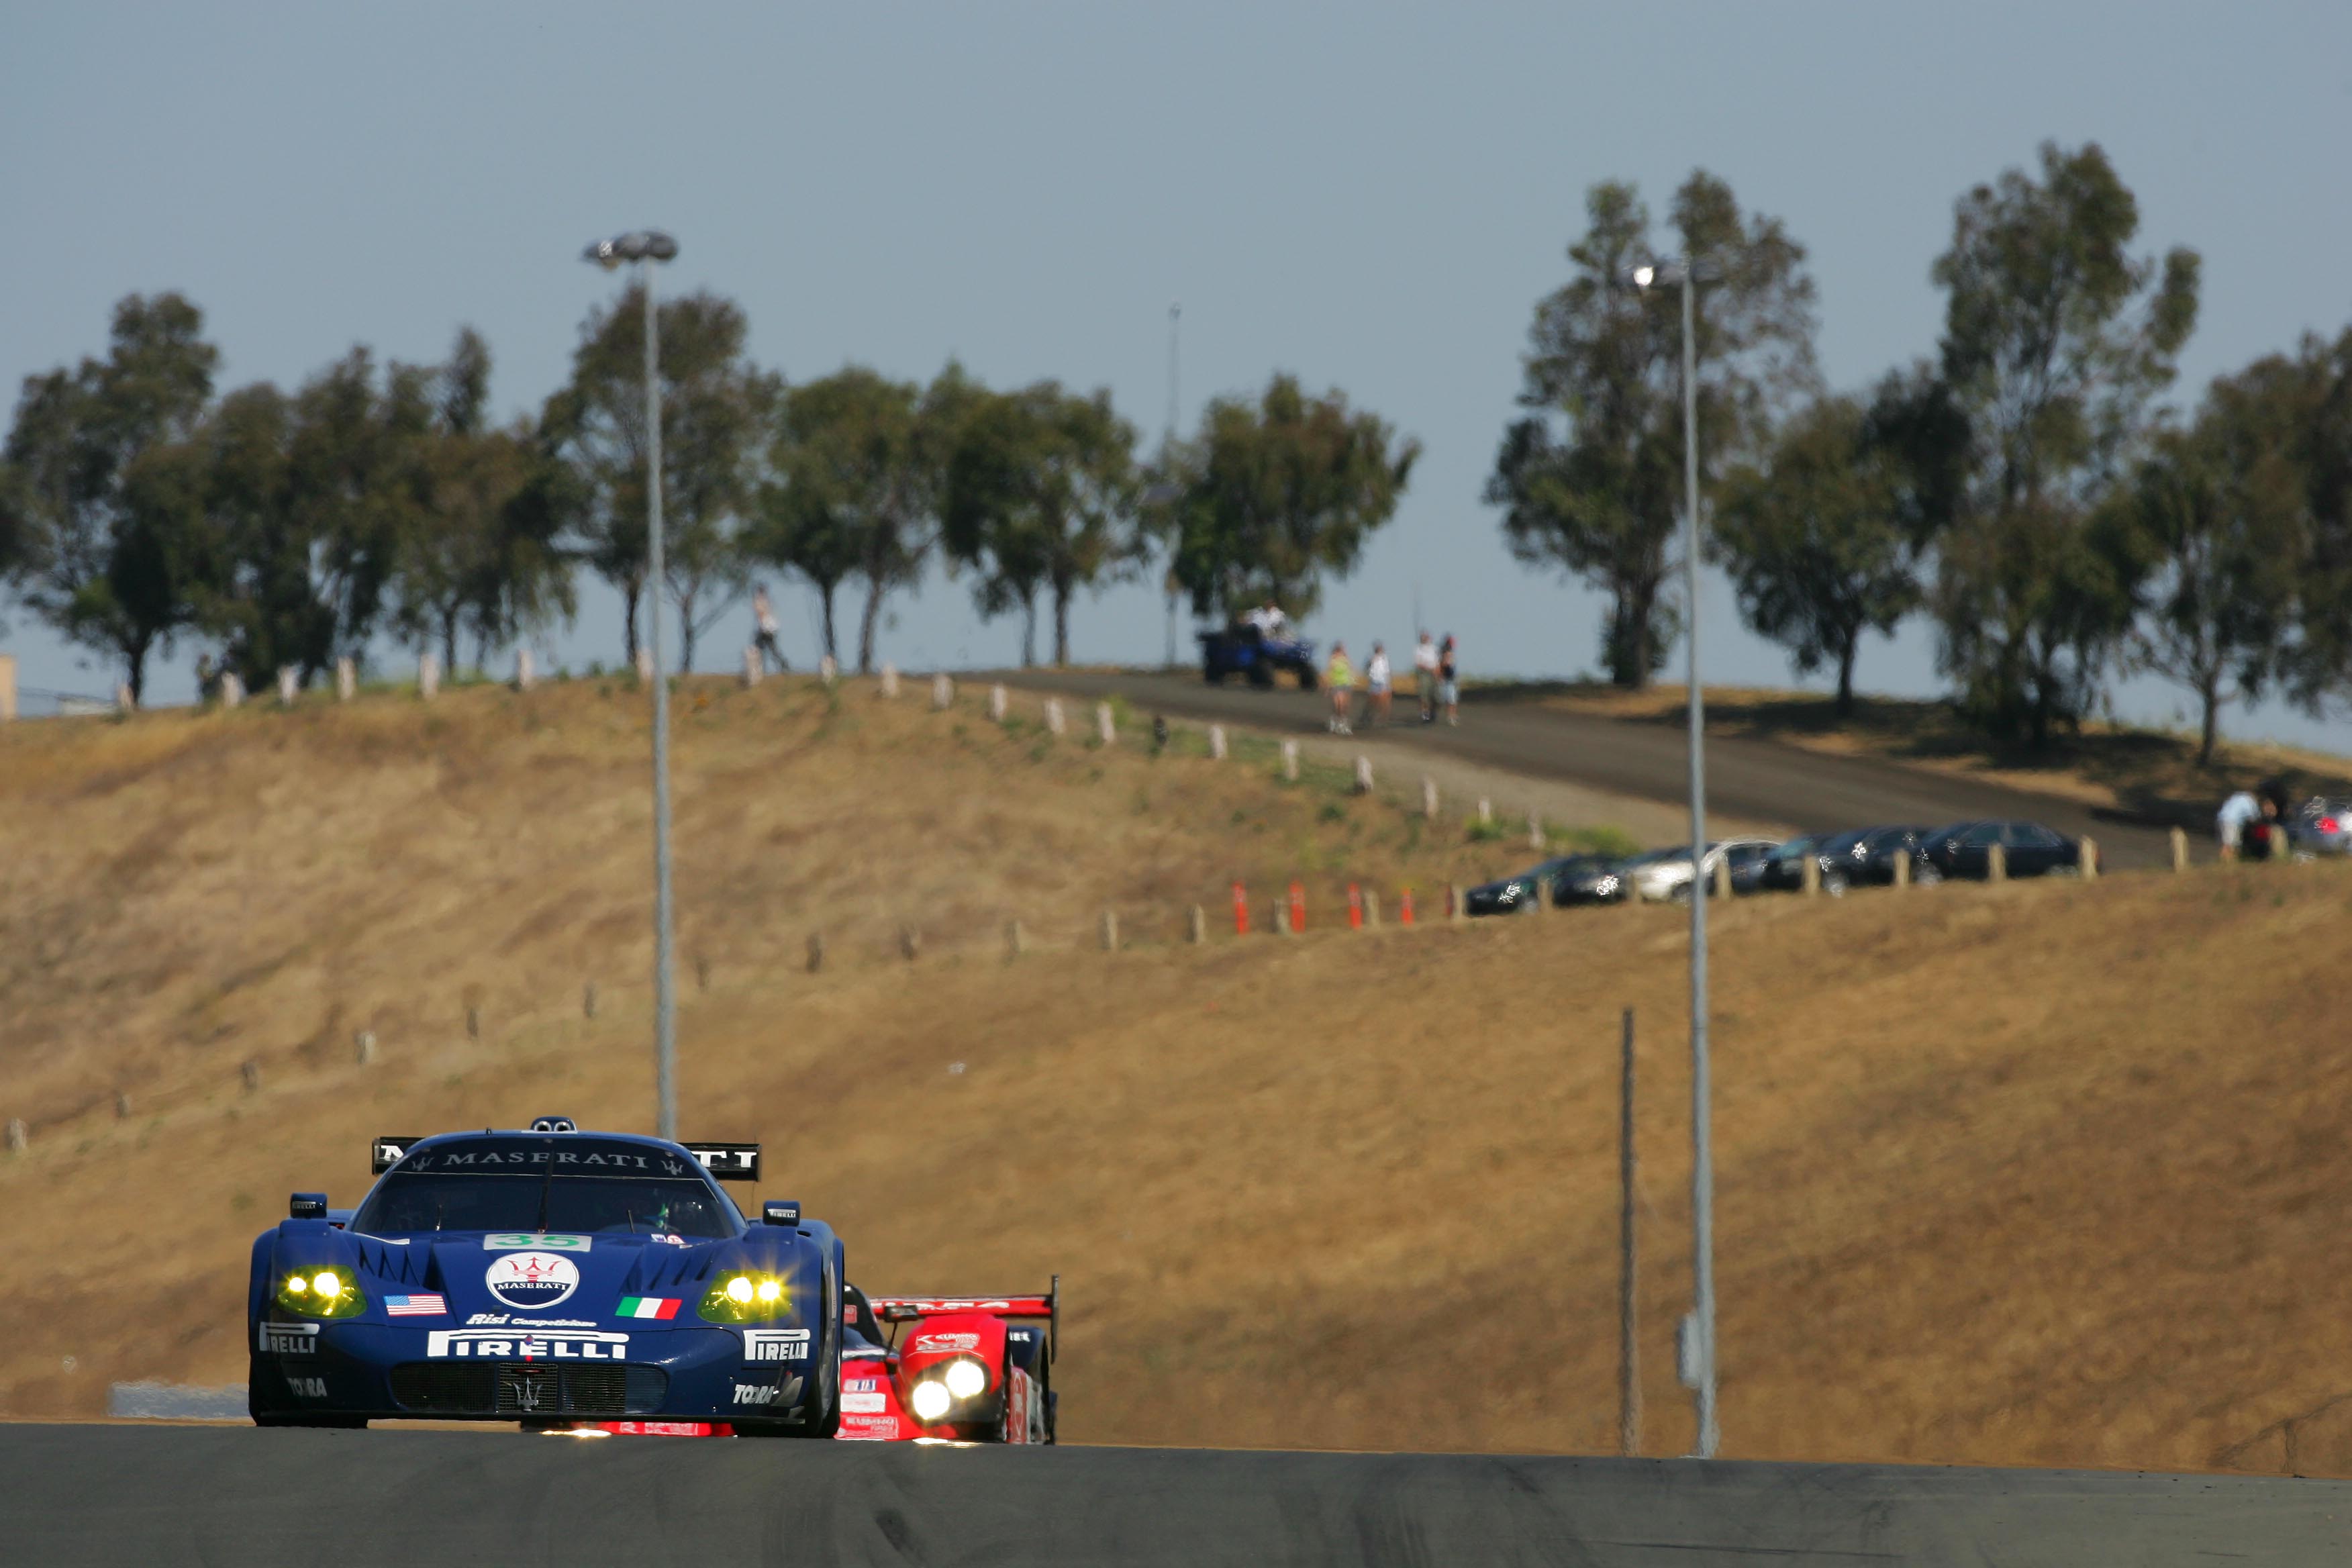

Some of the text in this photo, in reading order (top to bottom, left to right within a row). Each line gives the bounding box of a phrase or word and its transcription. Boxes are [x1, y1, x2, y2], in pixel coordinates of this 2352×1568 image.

[442, 1152, 649, 1169] MASERATI
[494, 1234, 580, 1246] 35
[497, 1282, 567, 1291] MASERATI
[466, 1314, 597, 1328] Risi Competizione
[259, 1321, 320, 1354] PIRELLI
[427, 1328, 630, 1359] PIRELLI
[743, 1328, 810, 1361] PIRELLI
